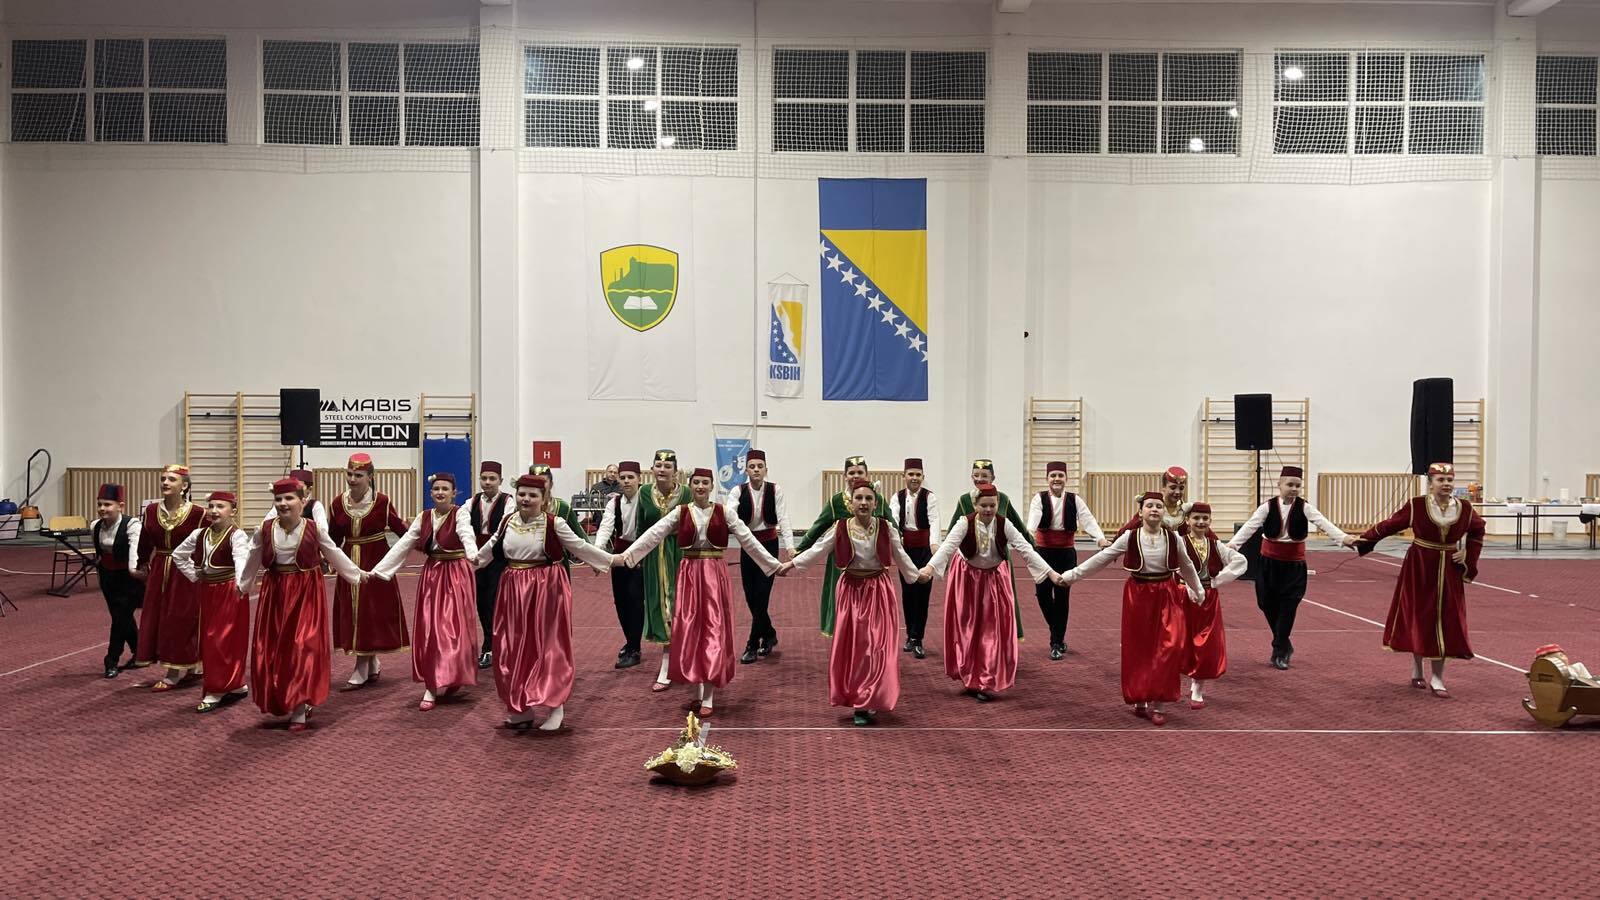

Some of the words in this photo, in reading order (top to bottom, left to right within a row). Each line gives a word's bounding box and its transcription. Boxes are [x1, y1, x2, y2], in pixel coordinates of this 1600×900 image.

[770, 365, 800, 380] KSBIH
[342, 399, 411, 411] MABIS
[341, 425, 409, 439] EMCON
[544, 451, 550, 459] H
